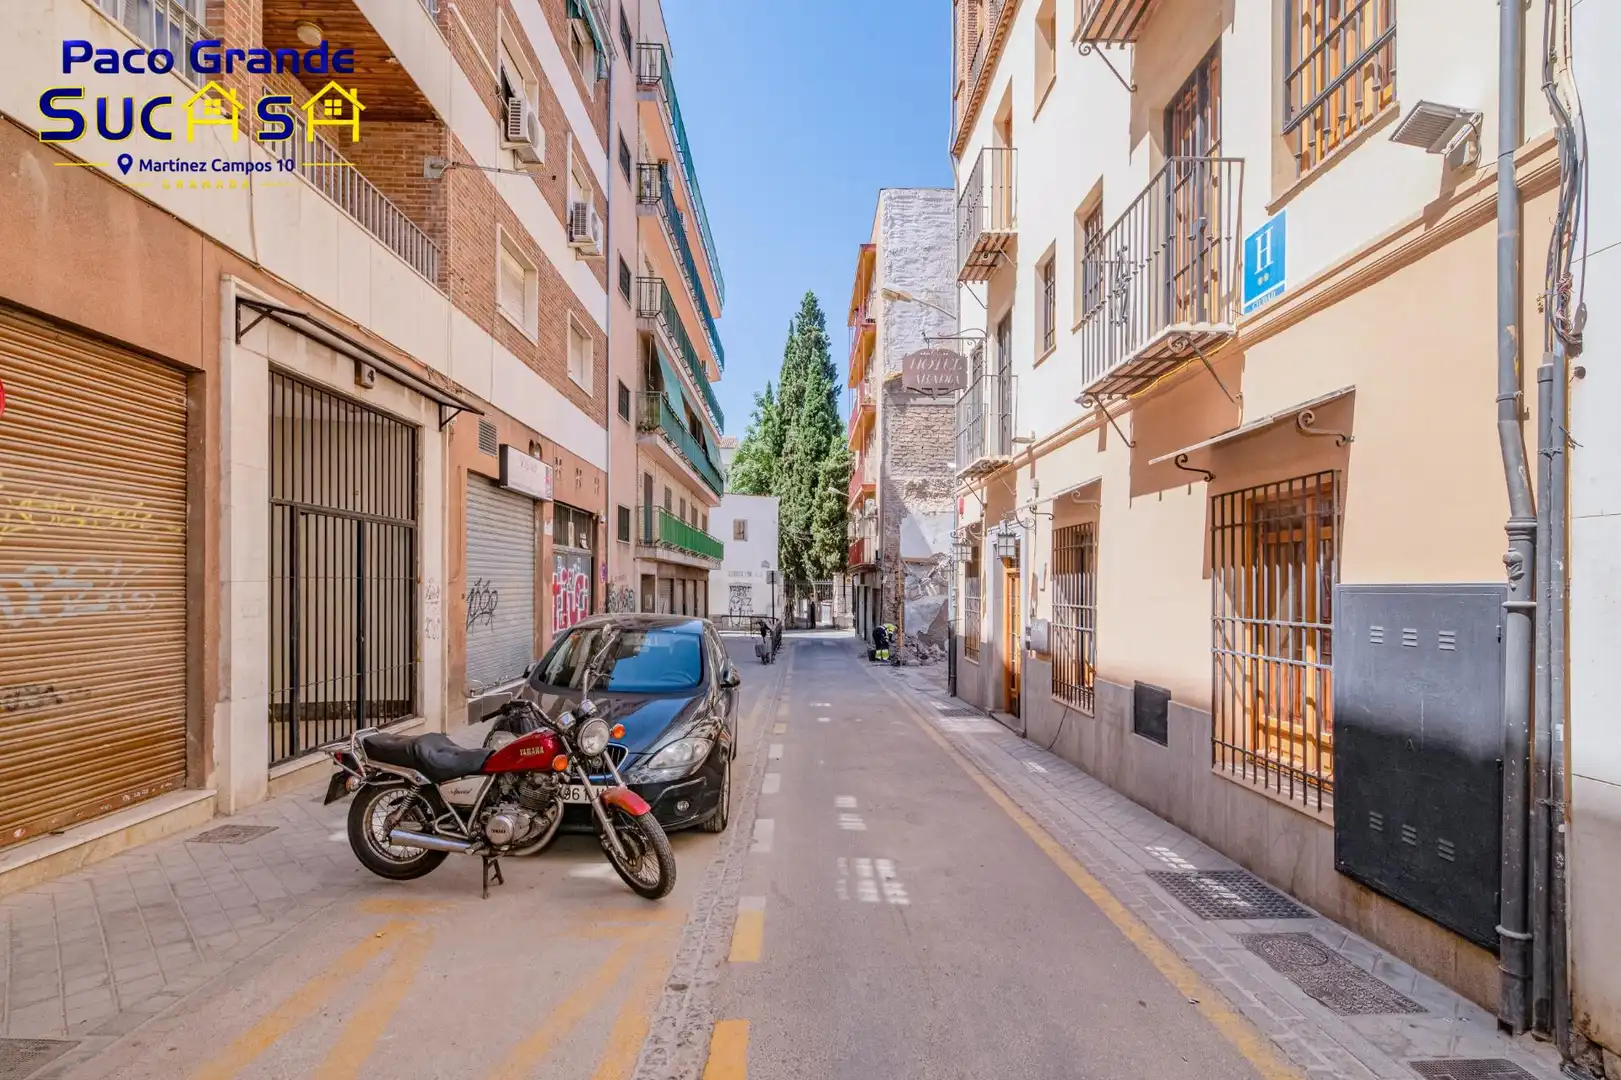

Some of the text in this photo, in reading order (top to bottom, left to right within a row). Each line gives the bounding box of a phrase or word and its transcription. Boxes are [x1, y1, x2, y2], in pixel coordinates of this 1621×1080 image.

[1254, 226, 1274, 275] H
[909, 358, 962, 371] HOTEL
[519, 745, 544, 756] YAMAHA
